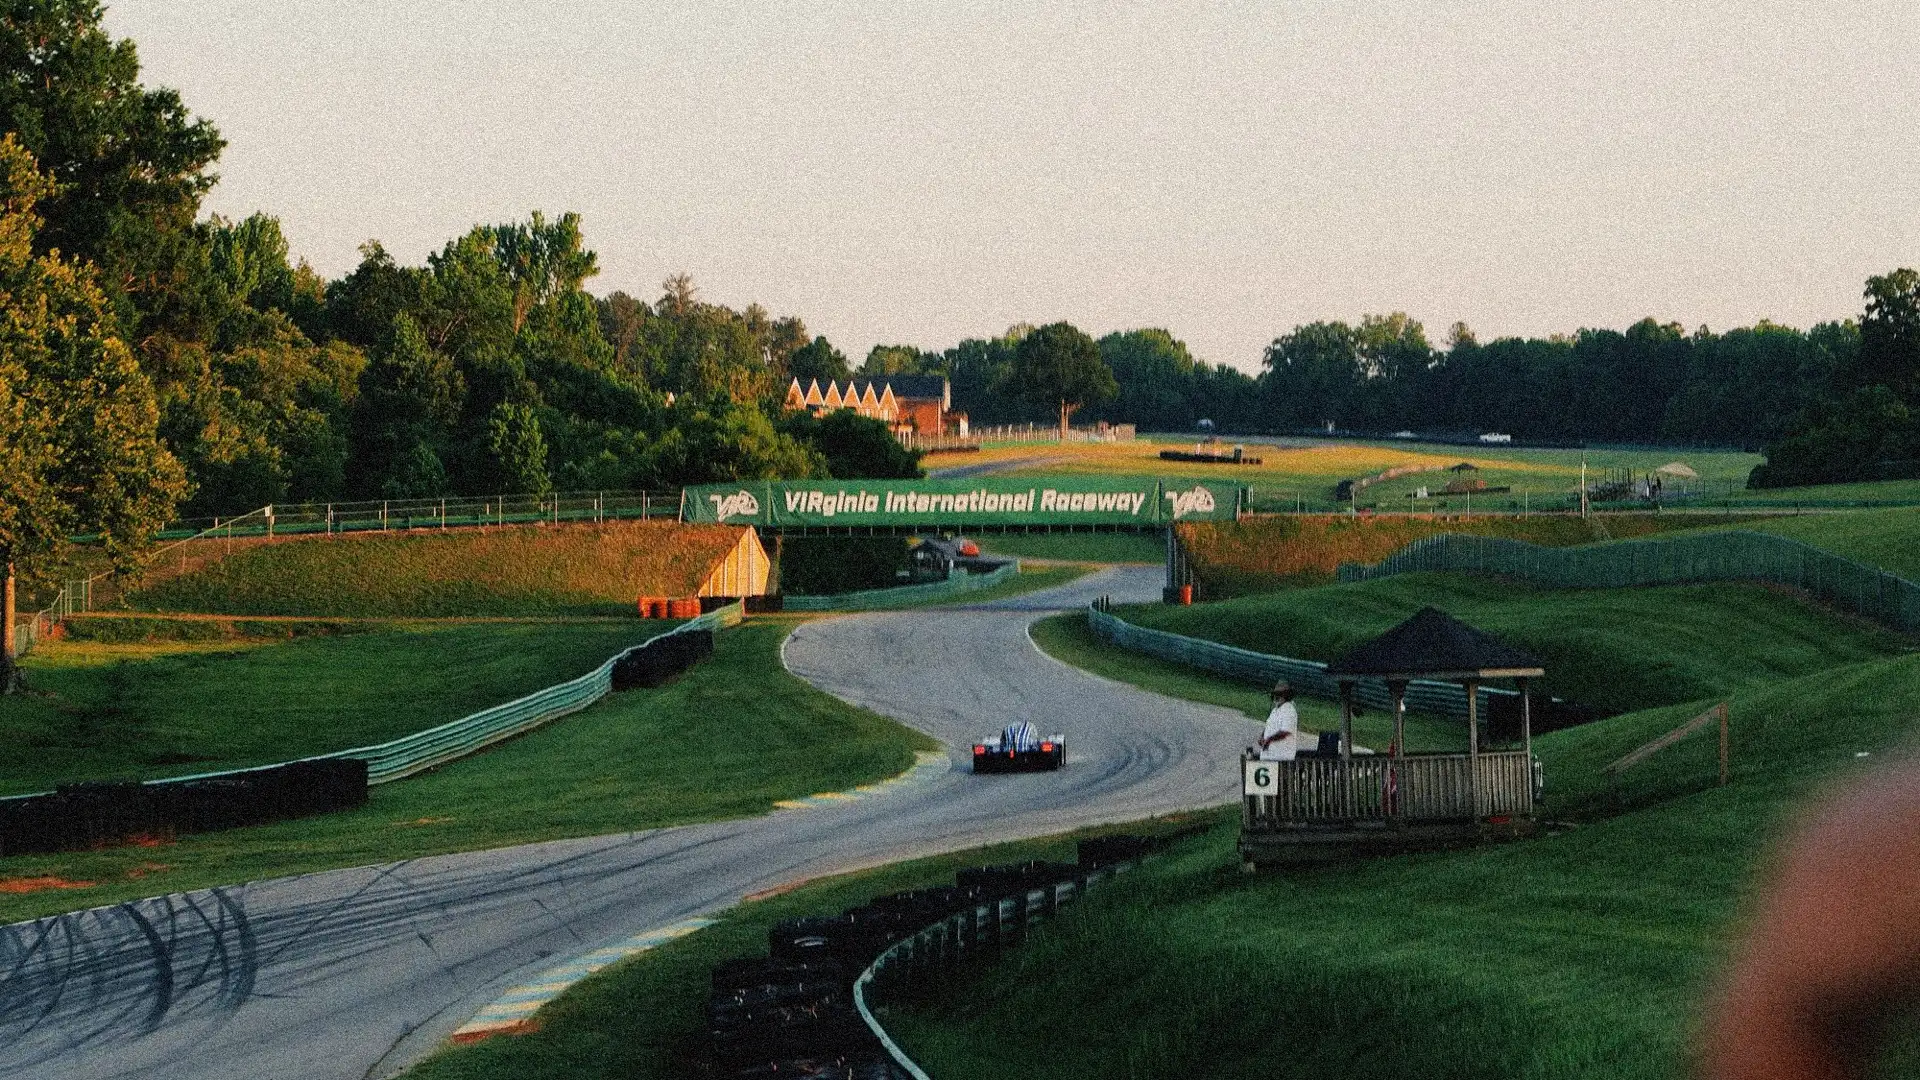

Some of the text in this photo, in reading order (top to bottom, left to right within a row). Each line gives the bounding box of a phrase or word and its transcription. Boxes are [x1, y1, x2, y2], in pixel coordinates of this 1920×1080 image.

[885, 488, 1036, 513] International
[1041, 488, 1145, 516] Raceway
[1254, 767, 1271, 788] 6
